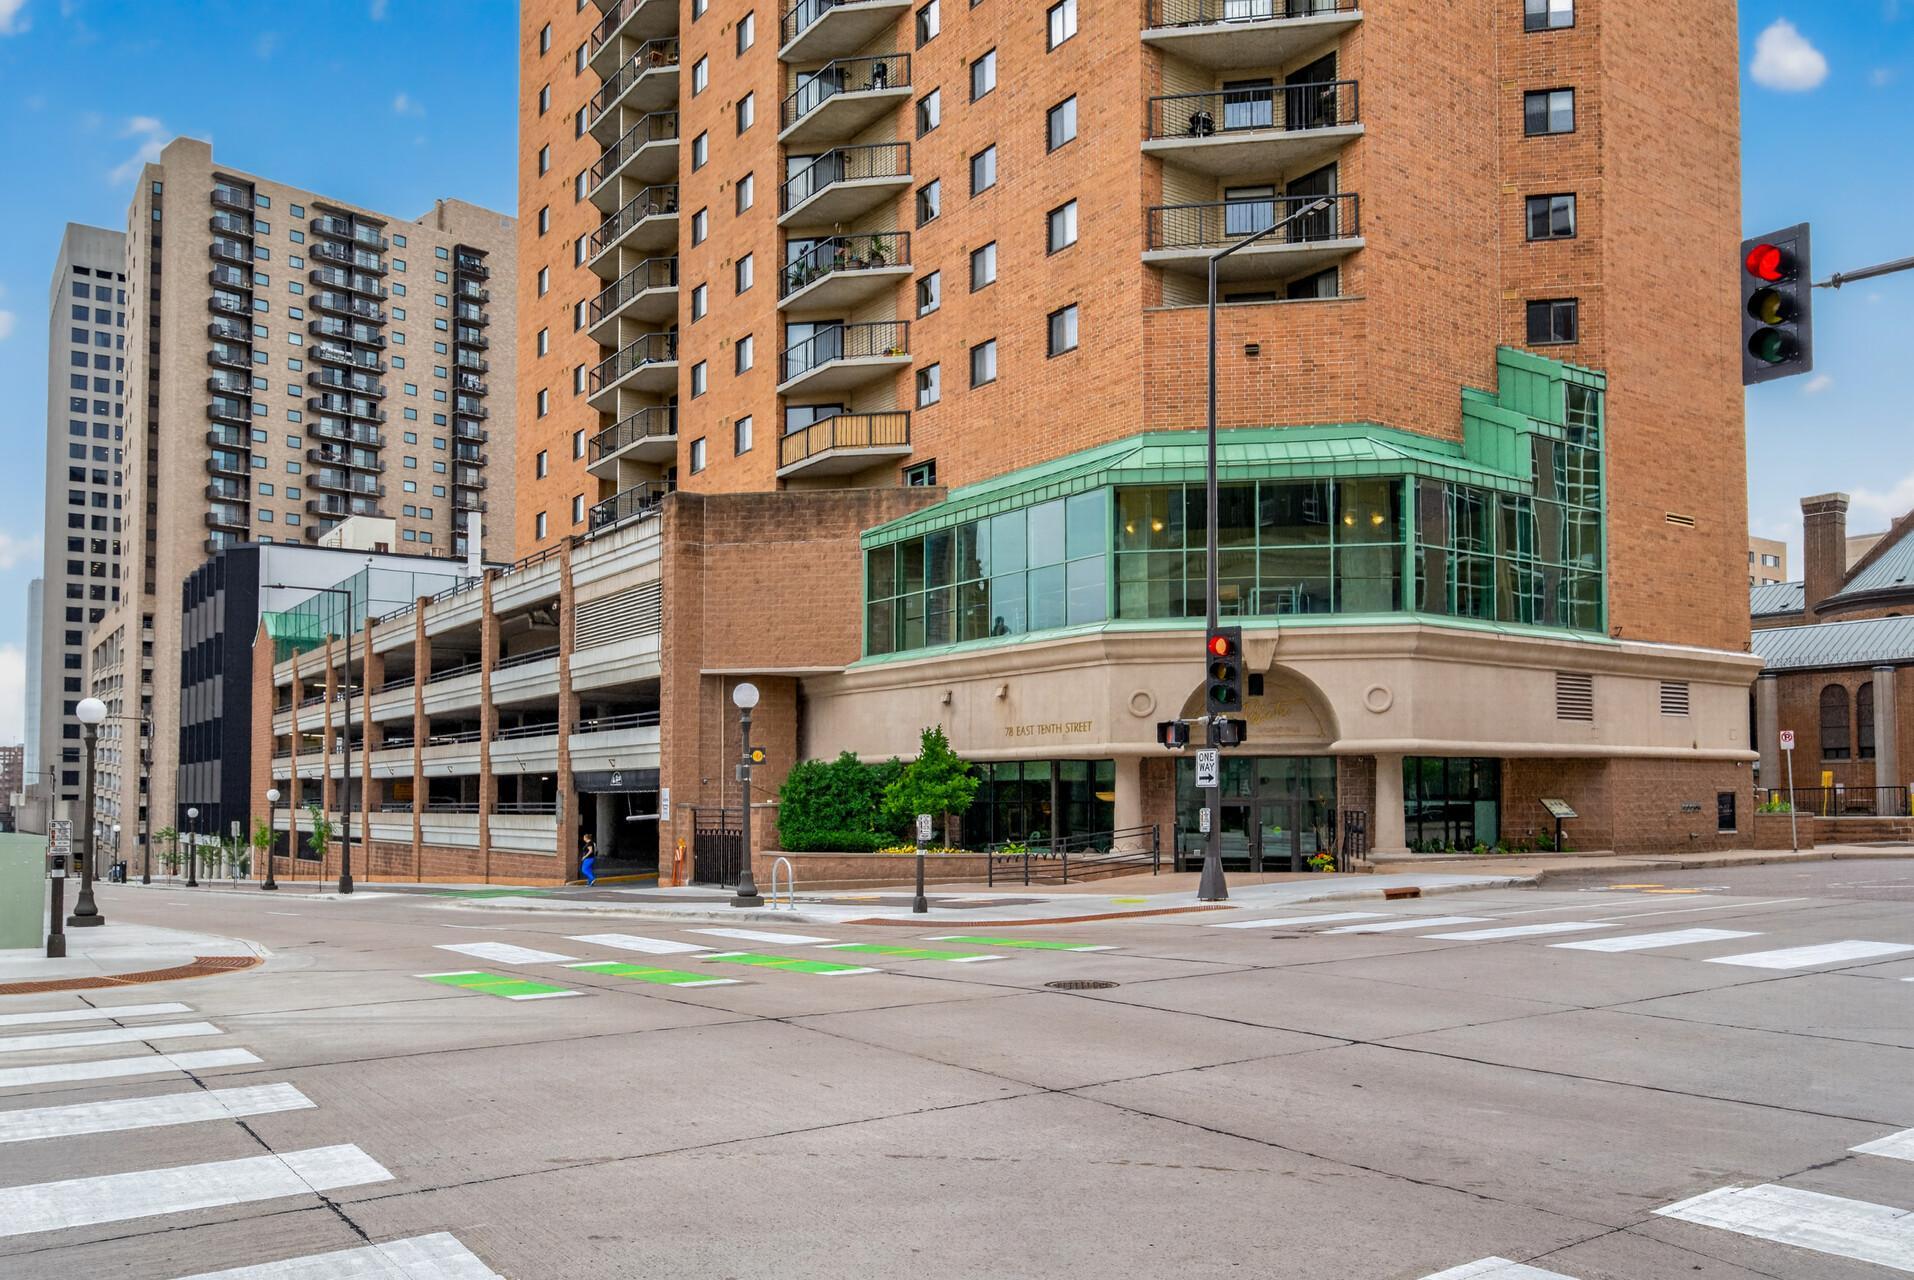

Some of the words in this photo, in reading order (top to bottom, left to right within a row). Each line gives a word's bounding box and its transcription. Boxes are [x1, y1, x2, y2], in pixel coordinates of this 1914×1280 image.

[1004, 726, 1014, 737] 78
[1016, 724, 1035, 737] EAST
[1037, 723, 1063, 735] TENTH
[1065, 720, 1092, 734] STREET
[1198, 752, 1214, 761] ONE
[1199, 762, 1215, 771] WAY
